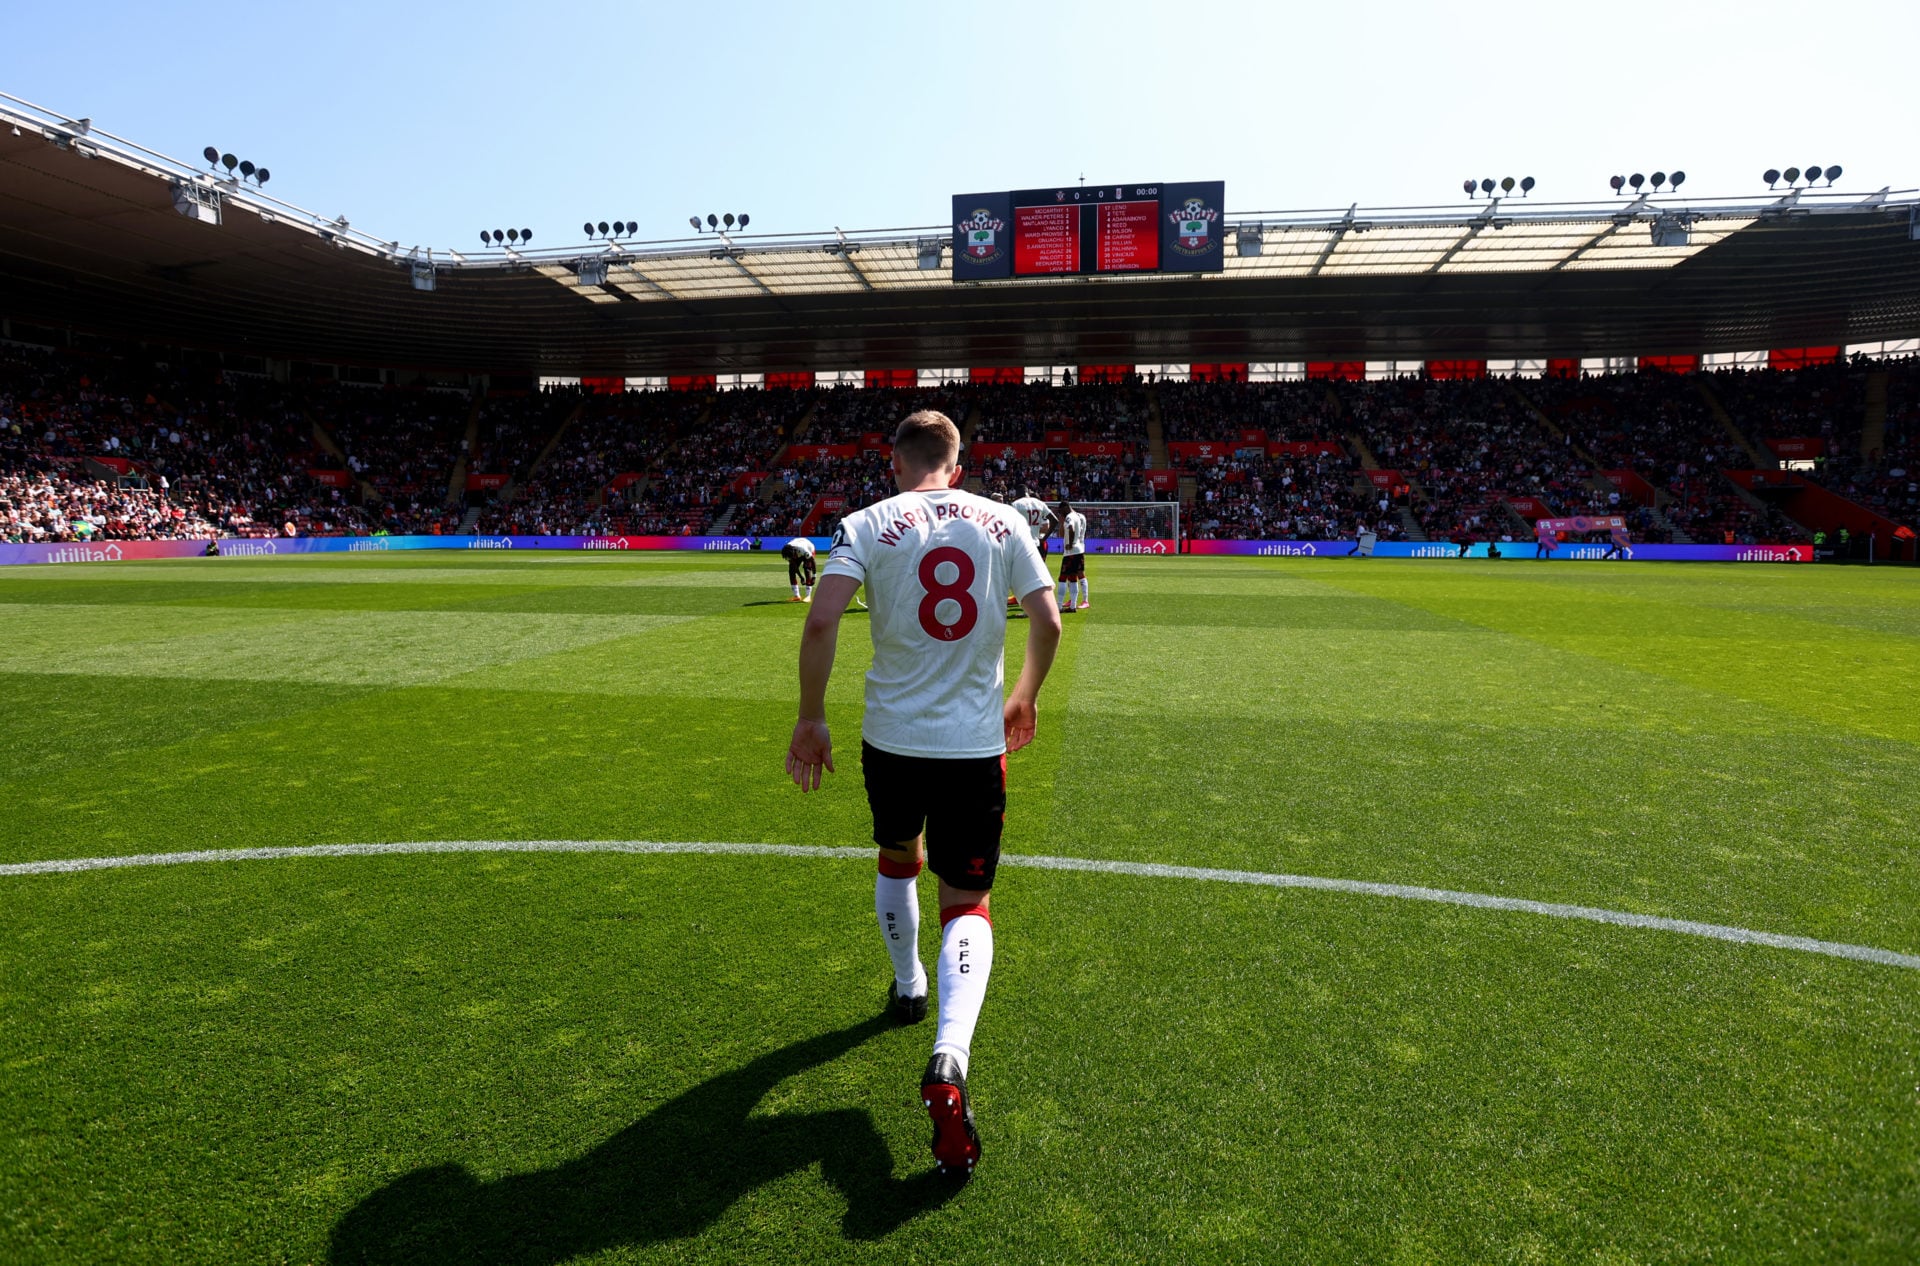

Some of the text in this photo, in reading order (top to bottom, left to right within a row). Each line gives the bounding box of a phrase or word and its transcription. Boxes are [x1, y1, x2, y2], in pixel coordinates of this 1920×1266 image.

[1074, 192, 1080, 200] 0
[1098, 190, 1104, 198] 0
[1136, 188, 1157, 196] 00:00
[1027, 510, 1040, 526] 12
[878, 503, 1012, 547] WARD PROWSE
[348, 540, 379, 551] utilita
[468, 539, 501, 549] utilita
[583, 540, 617, 549] utilita
[703, 541, 739, 550] utilita
[1110, 543, 1152, 554] utilita
[48, 547, 104, 563] utilita
[223, 543, 263, 557] utilita
[1258, 545, 1301, 555] utilita
[1411, 546, 1456, 557] utilita
[1737, 550, 1785, 561] utilita
[918, 546, 978, 641] 8
